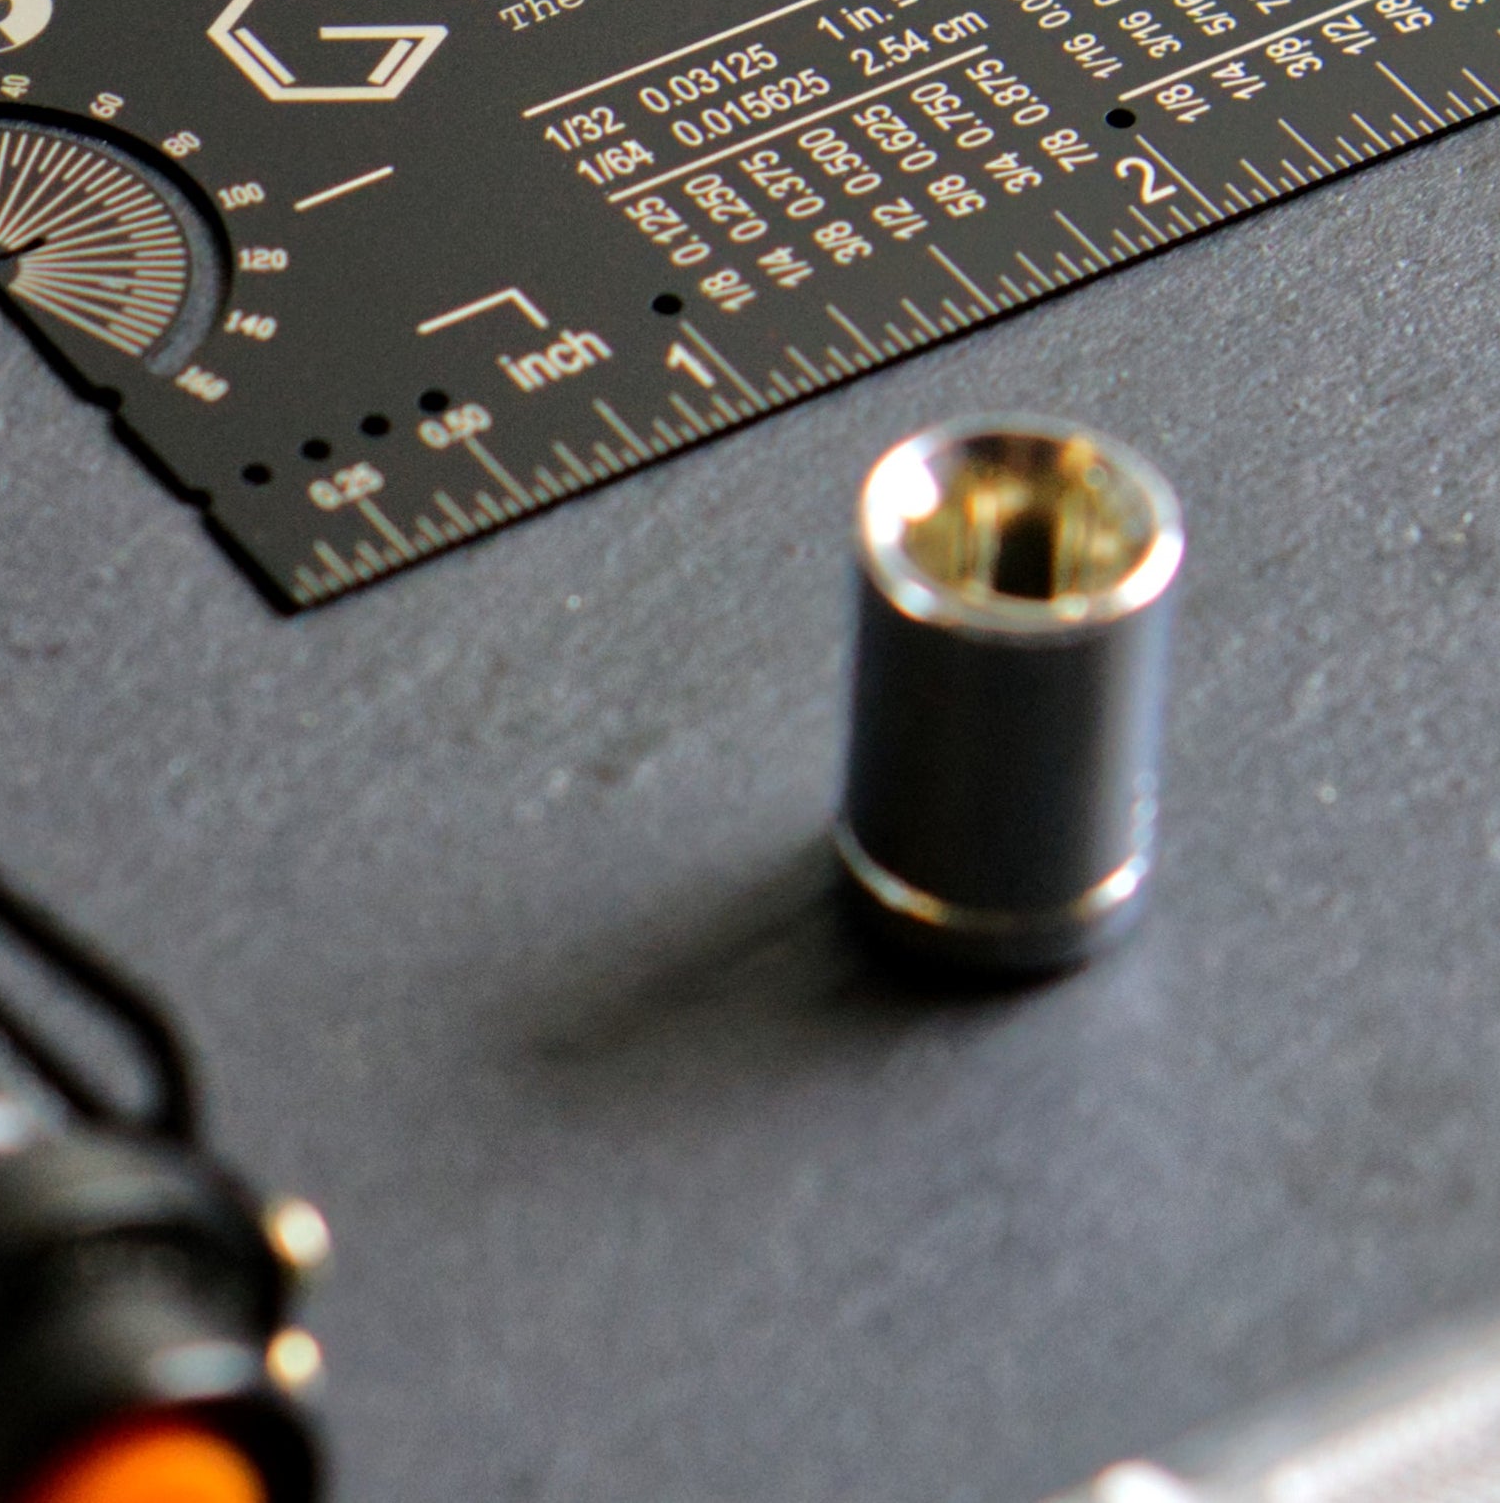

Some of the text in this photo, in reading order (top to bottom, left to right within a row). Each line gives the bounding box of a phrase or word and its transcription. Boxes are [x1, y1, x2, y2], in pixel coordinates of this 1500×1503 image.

[1063, 33, 1123, 79] 1/16
[1118, 11, 1182, 58] 3/16
[1265, 37, 1323, 78] 3/8
[1321, 14, 1377, 55] 1/2
[0, 74, 31, 99] 40
[544, 106, 626, 151] 1/32
[639, 43, 778, 113] 0.03125
[817, 16, 845, 41] 1
[840, 6, 894, 32] in.
[577, 11, 989, 185] 1/64 0.015625 2.54 cm
[1211, 61, 1267, 100] 1/4
[89, 92, 124, 119] 60
[965, 59, 1099, 172] 7/8 0.875
[1156, 83, 1211, 123] 1/8
[162, 131, 201, 158] 80
[852, 104, 986, 217] 5/8 0.625
[910, 82, 1043, 194] 3/4 0.750
[217, 182, 265, 210] 100
[798, 127, 928, 240] 1/2 0.500
[1115, 156, 1177, 204] 2
[684, 173, 813, 287] 1/4 0.250
[739, 150, 873, 265] 3/8 0.375
[239, 248, 288, 271] 120
[624, 196, 756, 311] 1/8 0.125
[224, 310, 277, 340] 140
[498, 329, 612, 391] inch
[667, 343, 715, 387] 1
